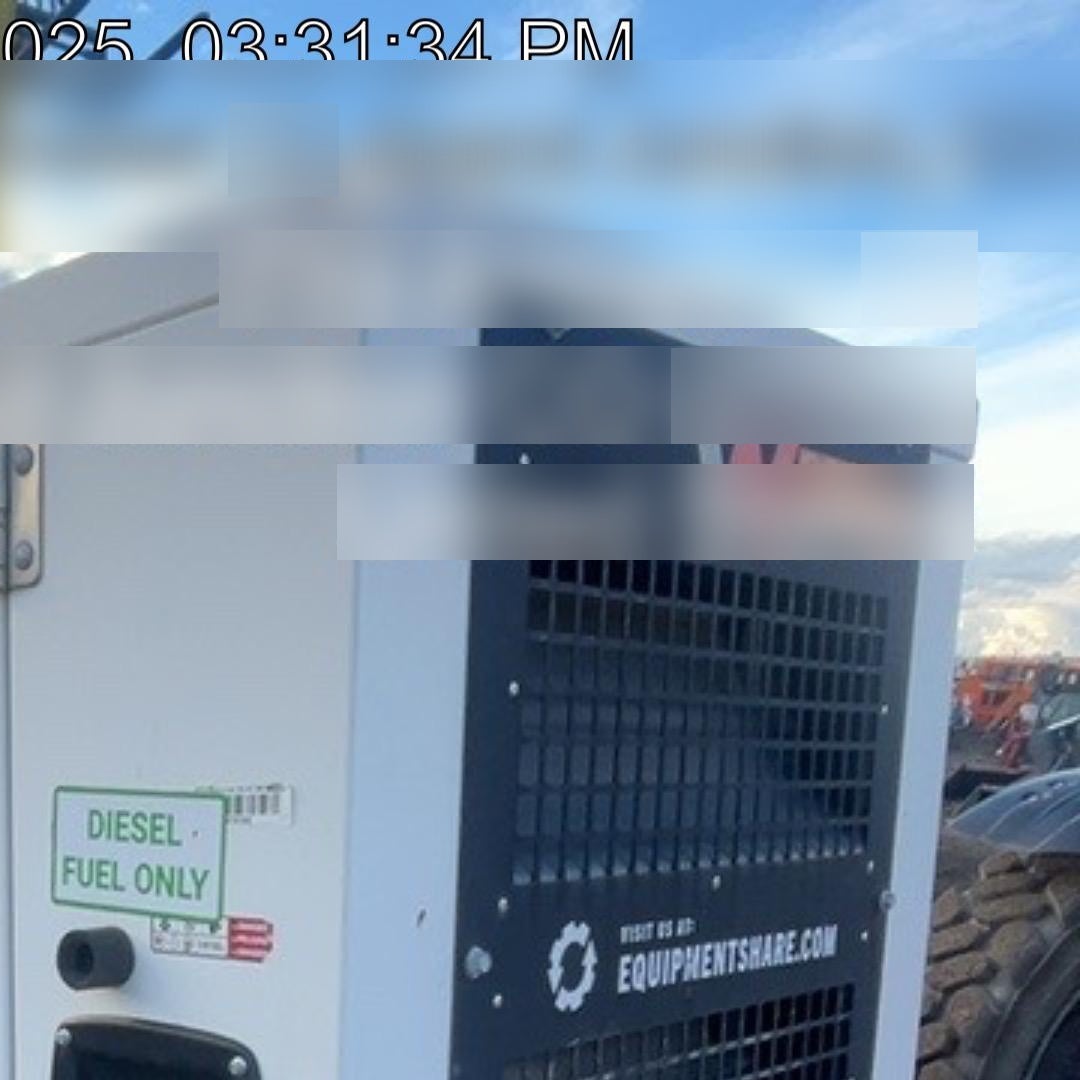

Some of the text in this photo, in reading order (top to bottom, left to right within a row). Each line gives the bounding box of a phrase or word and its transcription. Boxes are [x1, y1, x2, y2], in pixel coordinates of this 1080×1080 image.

[87, 809, 182, 847] DIESEL
[62, 855, 211, 901] FUEL ONLY
[620, 922, 654, 945] VISIT
[657, 919, 673, 939] US
[617, 923, 839, 995] EQUIPMENTSHARE.COM
